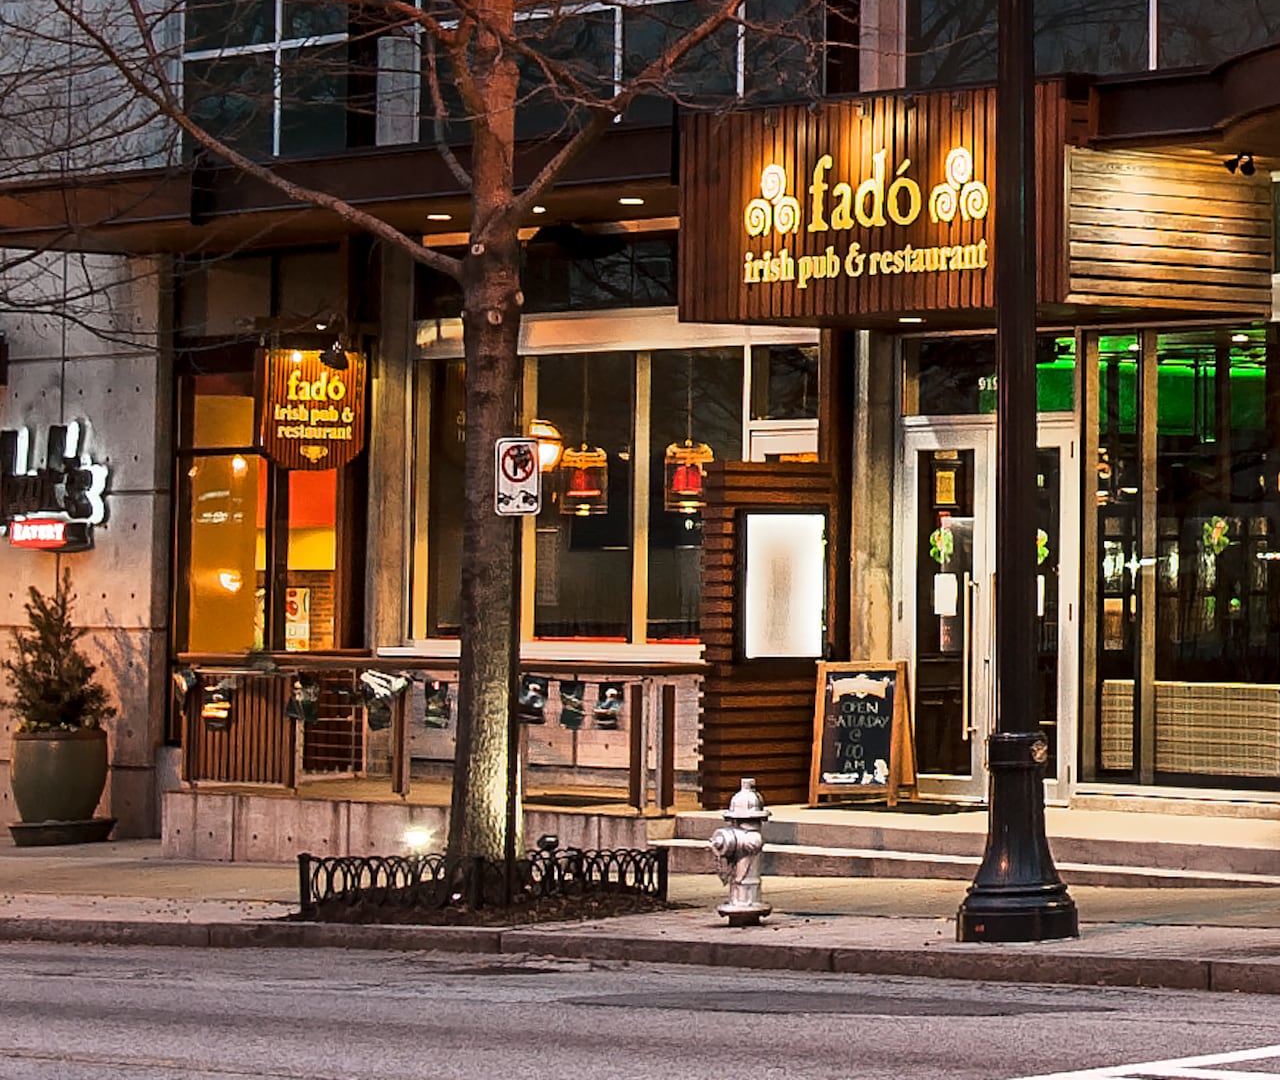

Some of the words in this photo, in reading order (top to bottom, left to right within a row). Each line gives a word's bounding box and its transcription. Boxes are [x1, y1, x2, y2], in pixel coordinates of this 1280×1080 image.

[808, 148, 922, 232] fadó
[744, 249, 795, 283] irish
[797, 246, 840, 288] pub
[845, 242, 865, 277] &
[869, 238, 988, 275] restaurant
[287, 369, 346, 401] fadó
[274, 404, 309, 421] irish
[310, 405, 339, 426] pub
[341, 407, 354, 423] &
[277, 425, 352, 439] restaurant
[842, 701, 879, 713] OPEN
[827, 715, 890, 729] SATURDAY
[844, 760, 865, 772] AM
